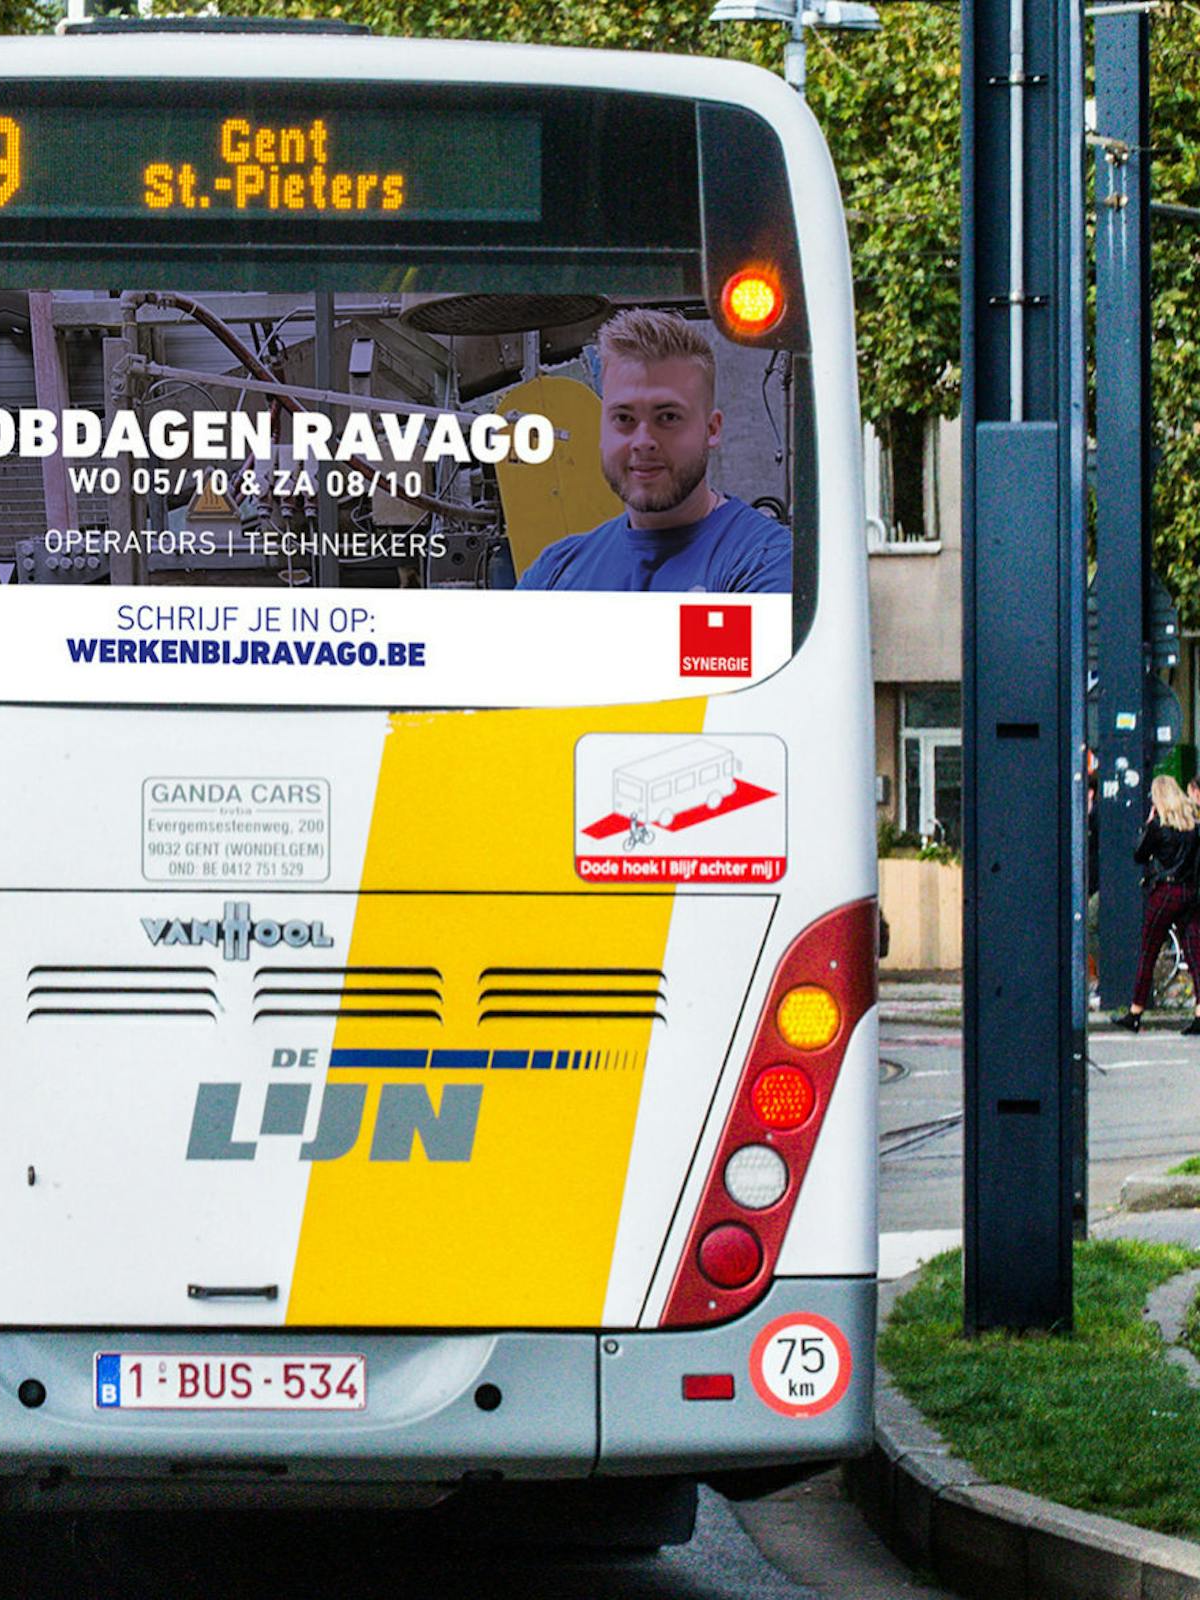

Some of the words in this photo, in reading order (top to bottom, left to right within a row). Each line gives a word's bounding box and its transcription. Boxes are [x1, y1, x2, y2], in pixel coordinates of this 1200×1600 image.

[220, 118, 328, 165] Gent
[143, 162, 404, 210] St.-Pieters
[292, 411, 555, 465] RAVAGO
[68, 468, 121, 495] WO
[133, 469, 229, 497] 05/10
[240, 471, 261, 497] &
[271, 471, 317, 498] ZA
[325, 471, 422, 500] 08/10
[44, 529, 216, 556] OPERATORS
[243, 531, 447, 559] TECHNIEKERS
[117, 605, 239, 632] SCHRIJF
[249, 607, 281, 632] JE
[293, 607, 319, 632] IN
[329, 608, 376, 633] OP:
[66, 638, 426, 667] WERKENBIJRAVAGO.BE
[682, 656, 749, 672] SYNERGIE
[151, 783, 243, 804] GANDA
[251, 784, 321, 804] CARS
[298, 819, 325, 833] 200
[185, 842, 220, 856] GENT
[580, 861, 618, 875] Dode
[622, 861, 658, 876] hoek
[670, 862, 698, 879] Blijf
[700, 863, 748, 876] achter
[751, 863, 773, 880] mij
[271, 1048, 318, 1068] DE
[185, 1082, 484, 1163] LIJN
[777, 1338, 825, 1375] 75
[101, 1384, 117, 1404] B
[788, 1378, 815, 1396] km
